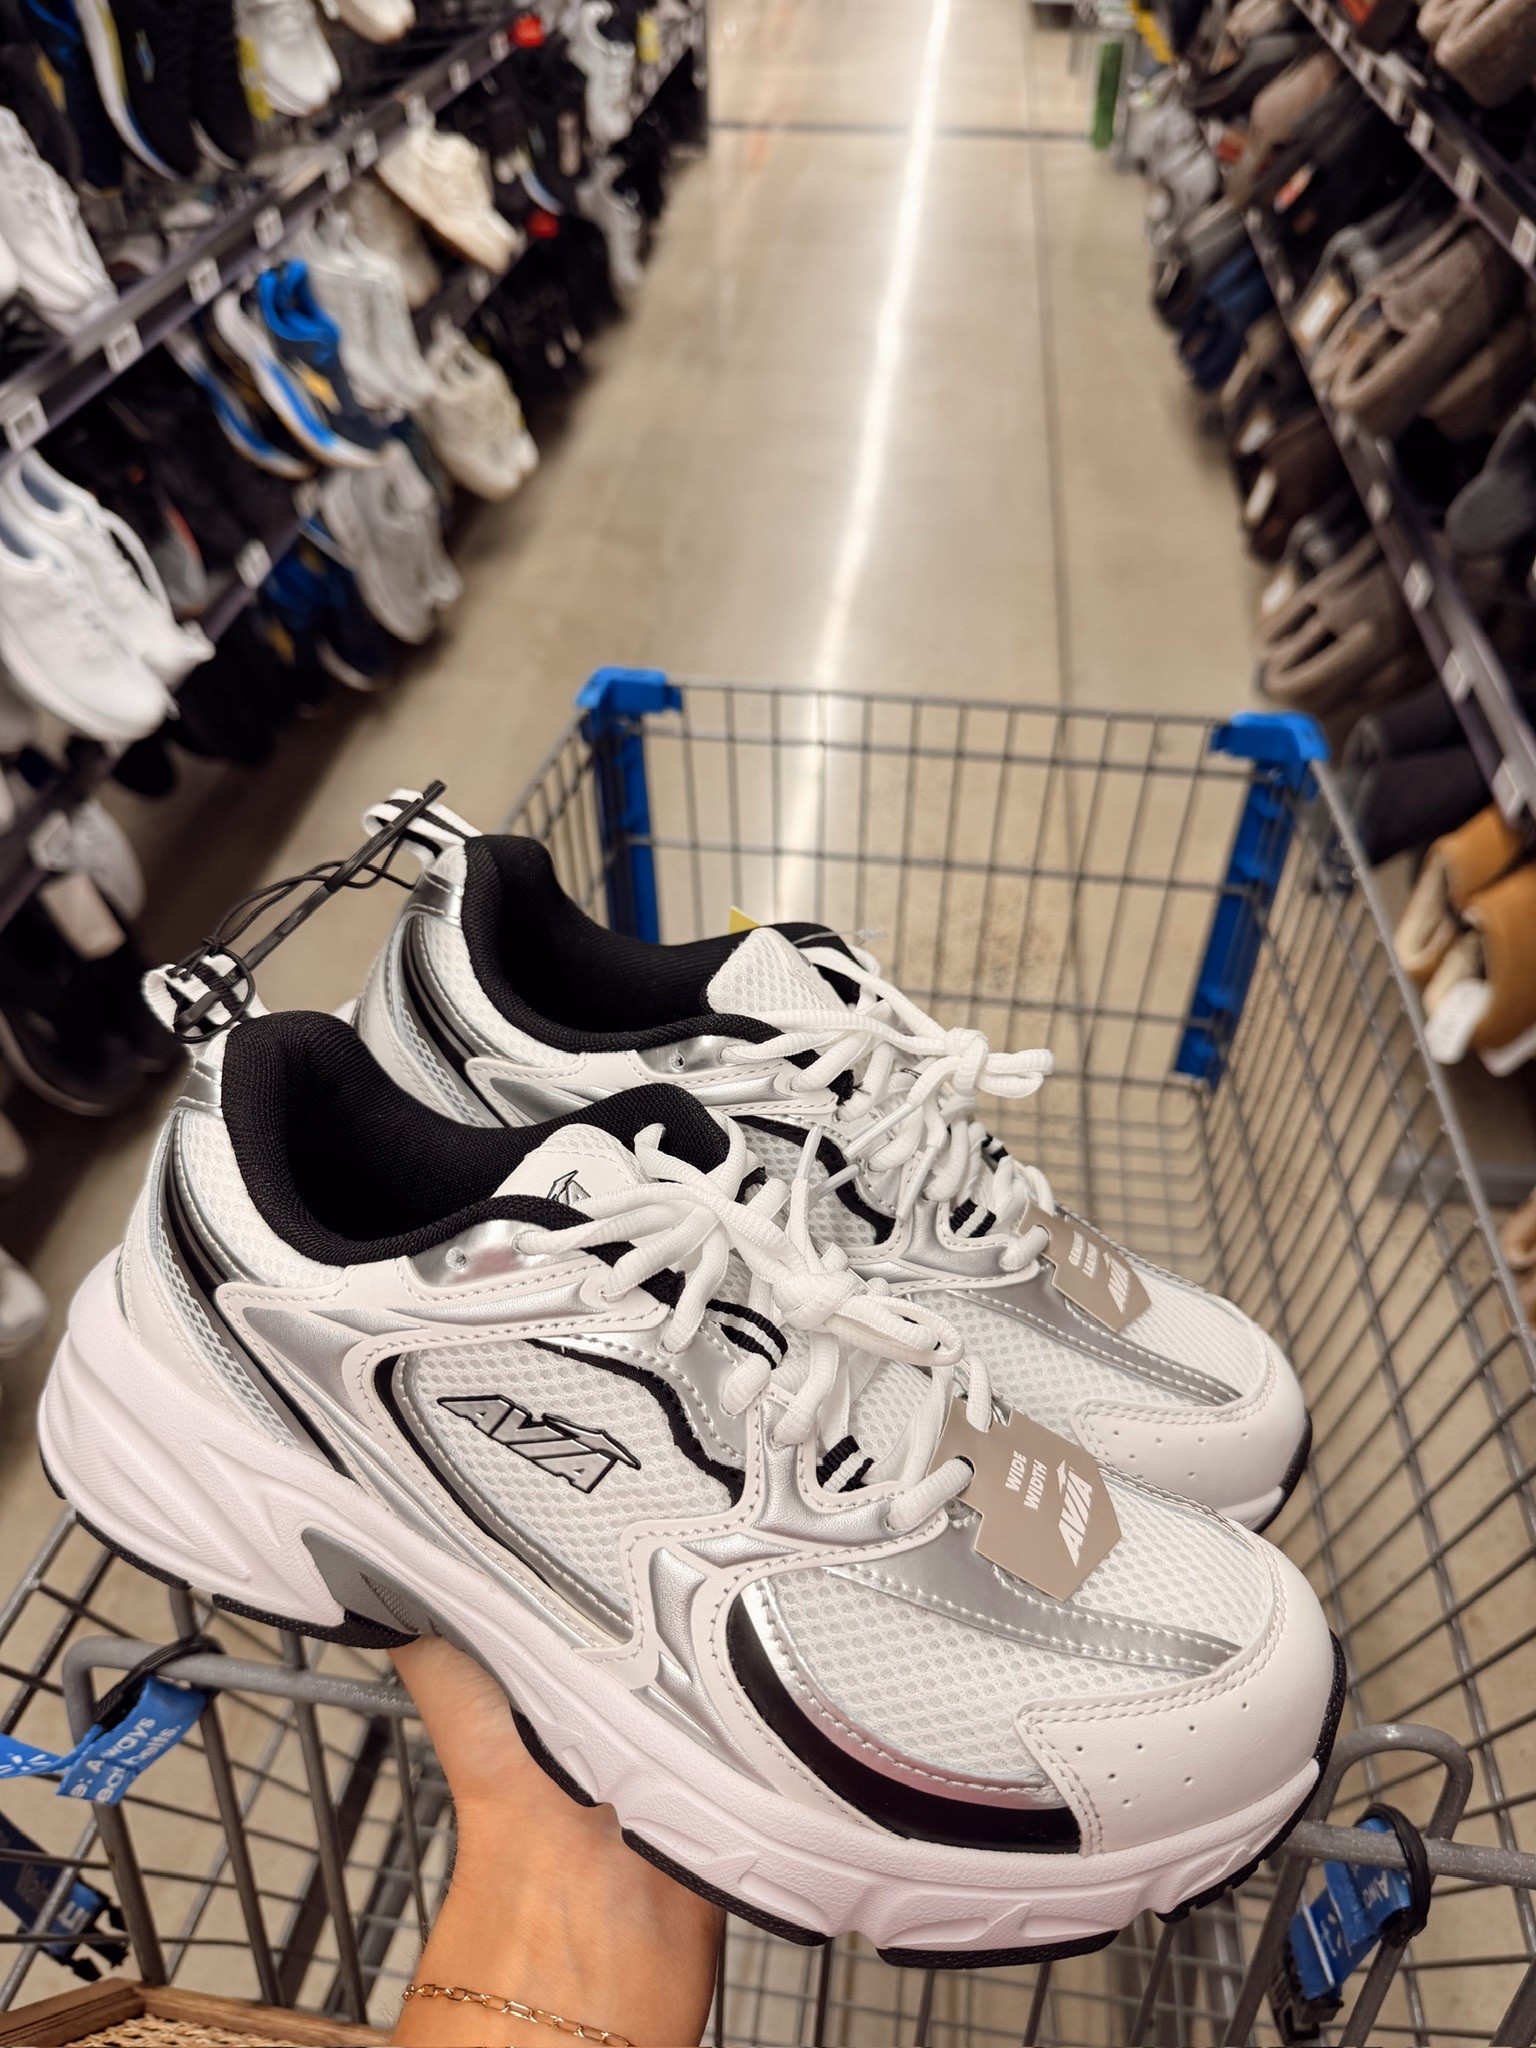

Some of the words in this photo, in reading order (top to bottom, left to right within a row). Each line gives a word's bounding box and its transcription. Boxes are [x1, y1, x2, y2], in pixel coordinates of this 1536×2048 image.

[437, 1394, 641, 1493] AVIA
[1005, 1450, 1027, 1493] WIDE
[1023, 1459, 1048, 1511] WIDTH
[1056, 1459, 1093, 1568] AVIA
[85, 1718, 156, 1774] Aways
